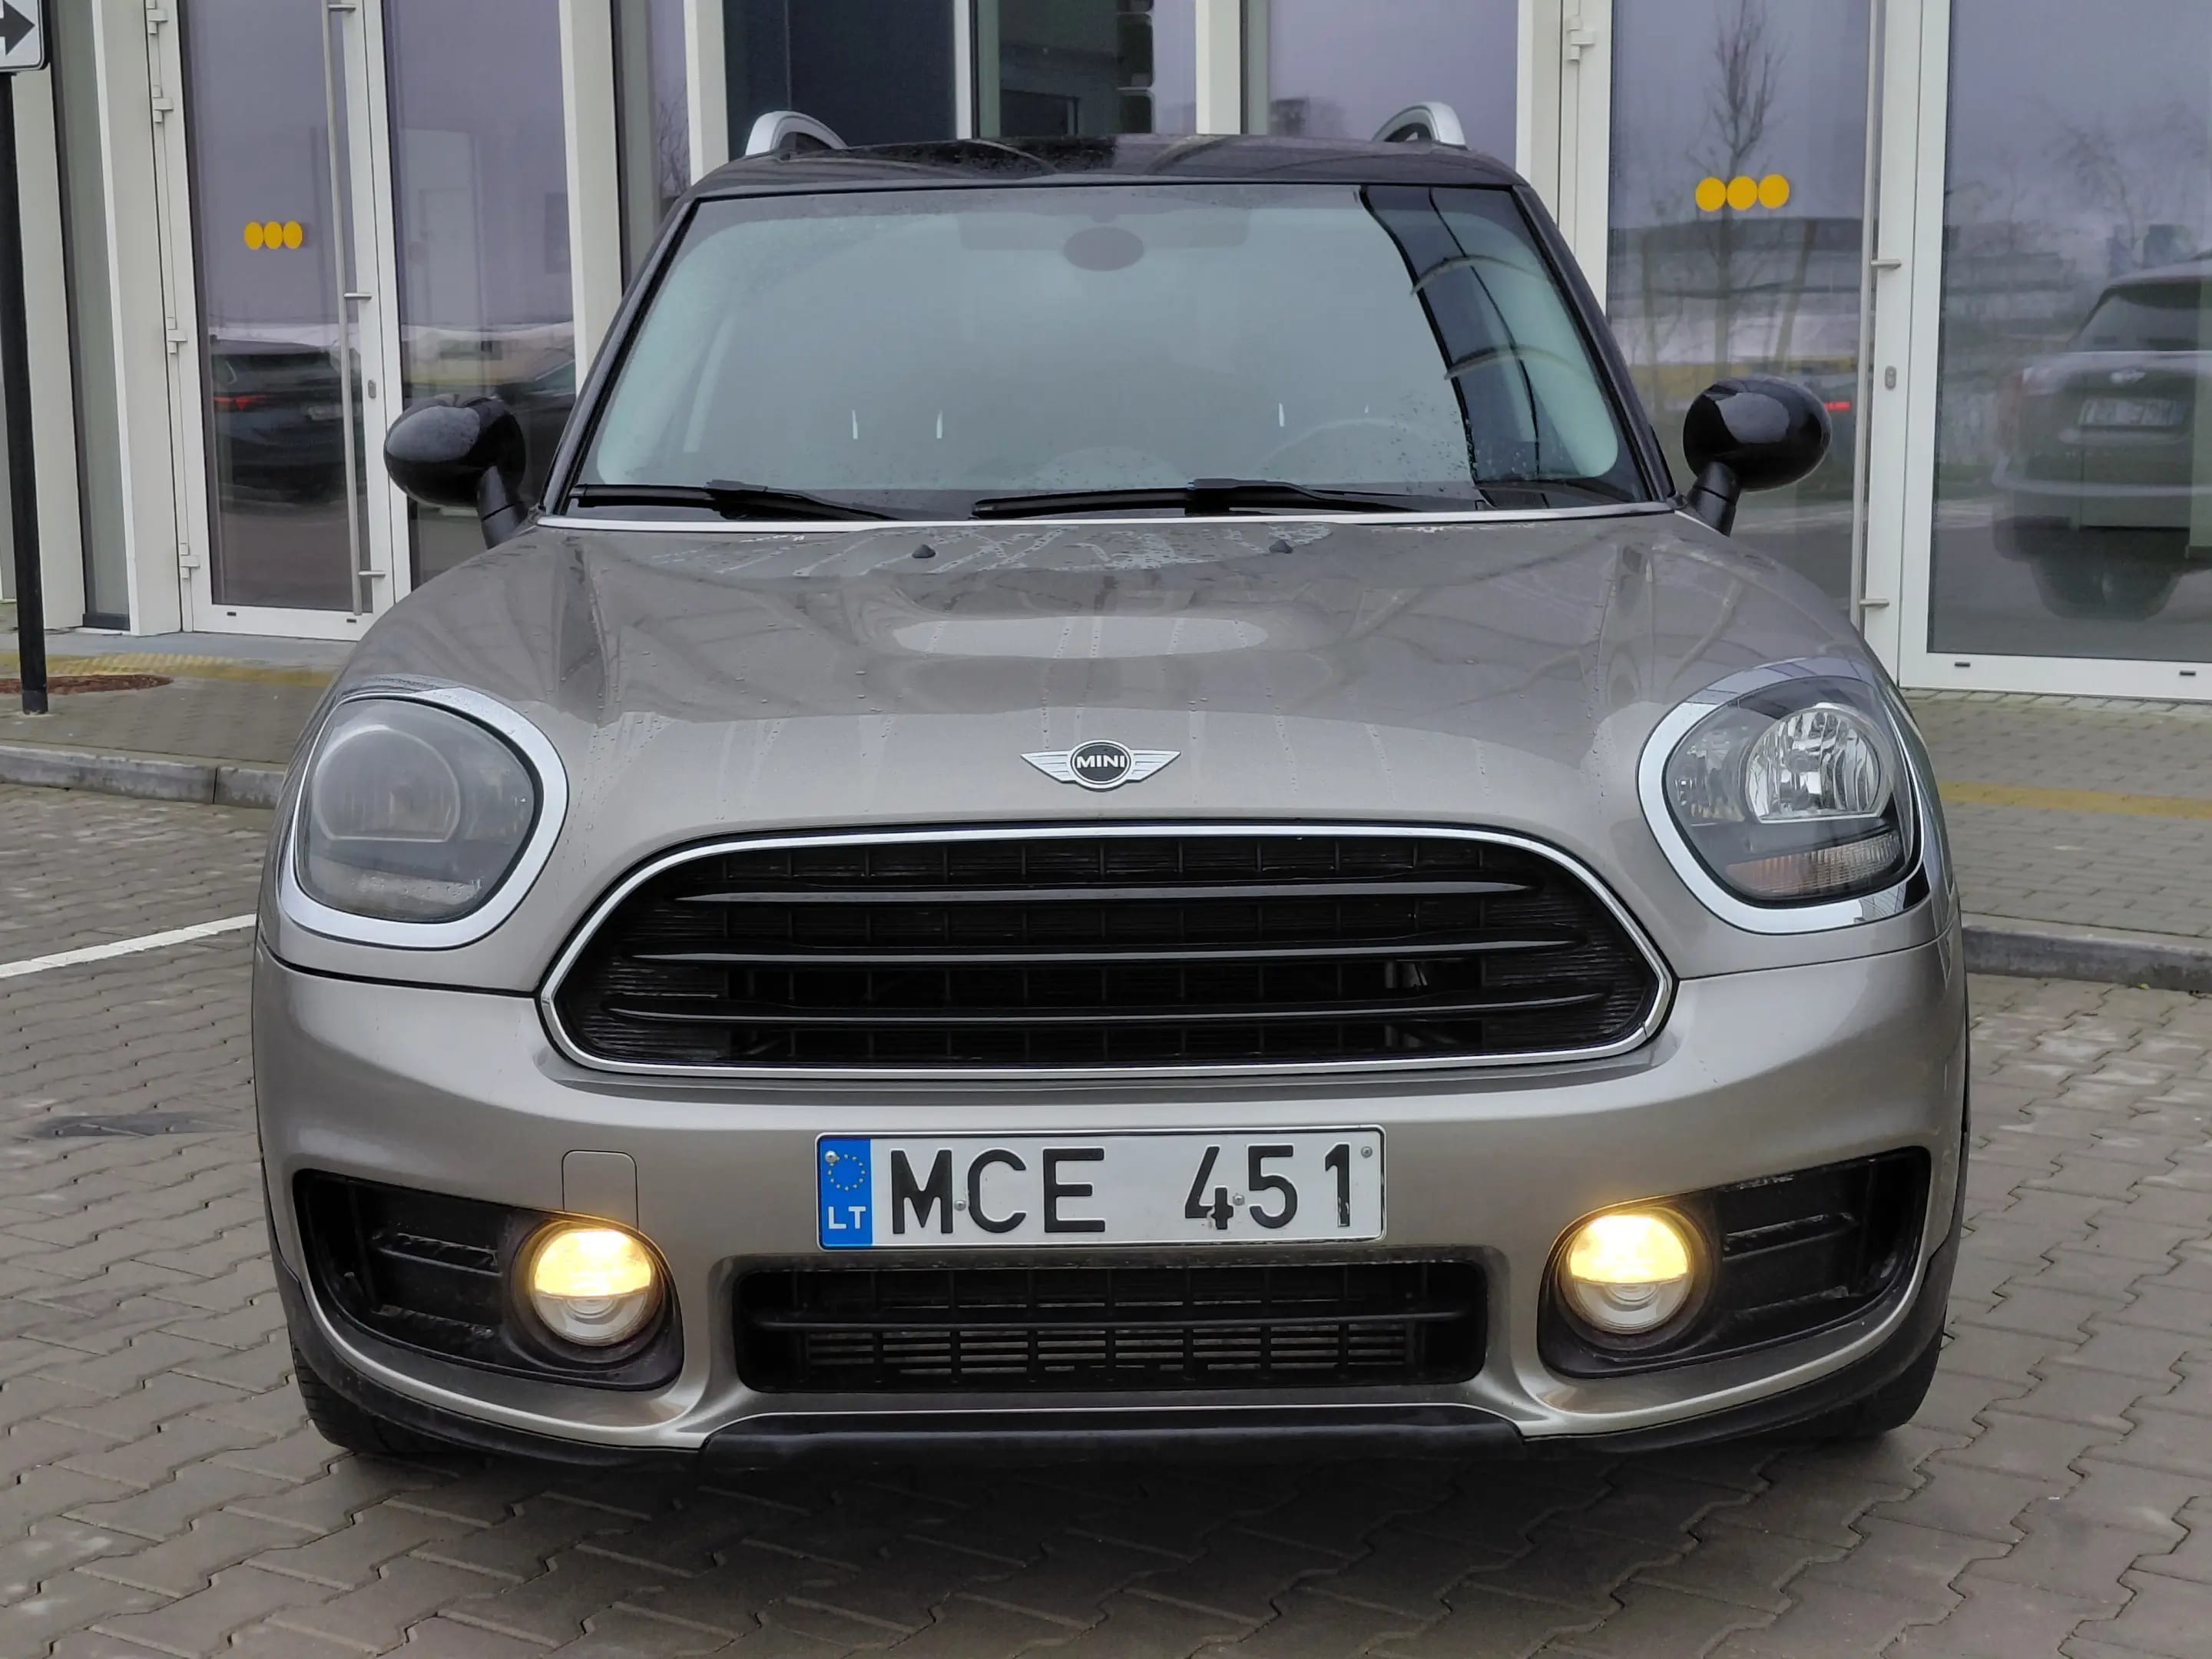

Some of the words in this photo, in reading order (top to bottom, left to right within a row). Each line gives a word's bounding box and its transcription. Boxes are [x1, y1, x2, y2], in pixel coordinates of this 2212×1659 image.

[1077, 754, 1125, 769] MINI
[891, 1147, 1106, 1234] MCE
[1184, 1144, 1350, 1230] 451
[828, 1205, 866, 1230] LT
